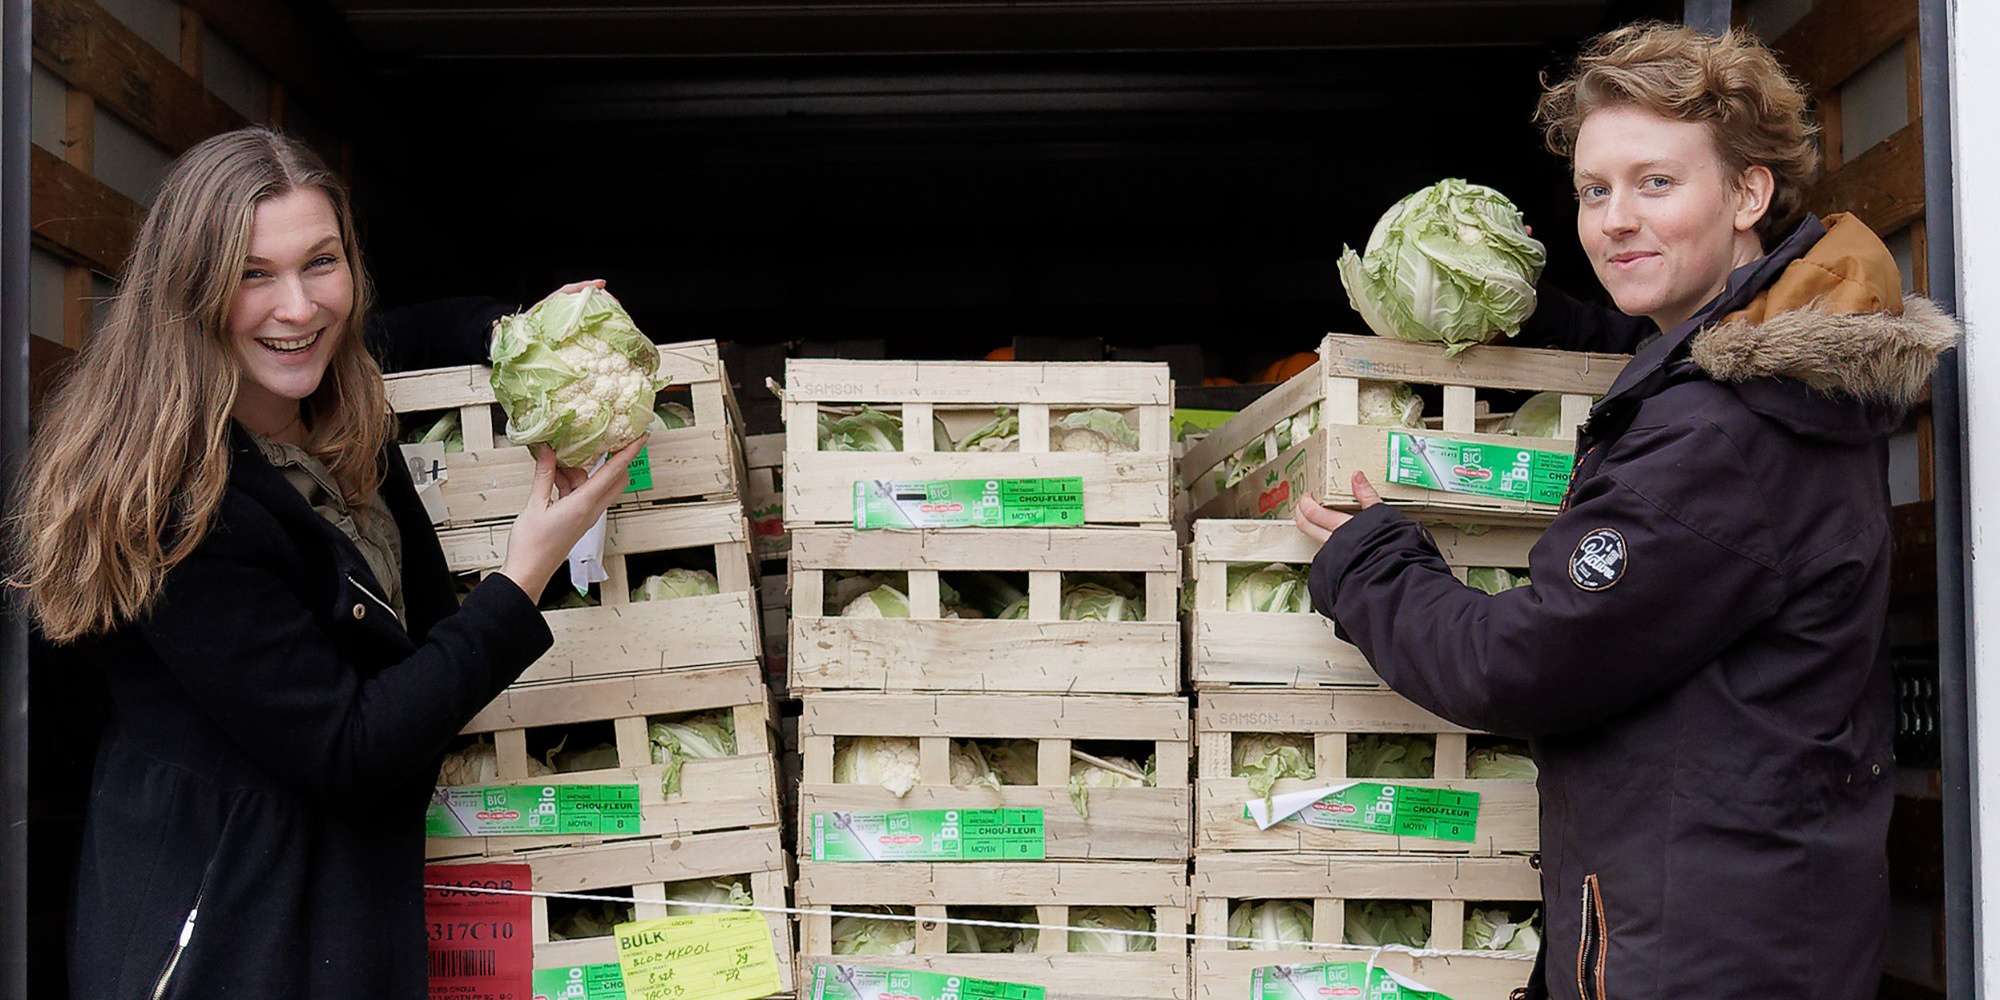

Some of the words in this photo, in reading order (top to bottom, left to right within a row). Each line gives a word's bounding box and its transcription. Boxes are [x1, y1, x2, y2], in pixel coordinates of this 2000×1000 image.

[804, 383, 864, 396] SAMSON
[874, 383, 880, 396] 1
[1462, 453, 1482, 464] BIO
[1511, 451, 1530, 480] Bio
[930, 487, 950, 500] BIO
[982, 480, 999, 506] Bio
[1018, 495, 1076, 503] CHOU-FLEUR
[1060, 511, 1067, 520] 8
[1219, 712, 1281, 725] SAMSON
[487, 794, 507, 806] BIO
[538, 787, 556, 814] Bio
[1376, 786, 1395, 813] Bio
[1413, 805, 1470, 818] CHOU-FLEUR
[617, 819, 624, 828] 8
[890, 818, 910, 830] BIO
[941, 810, 959, 839] Bio
[1403, 822, 1428, 831] MOYEN
[978, 827, 1036, 835] CHOU-FLEUR
[1451, 826, 1459, 835] 8
[1020, 844, 1028, 853] 8
[621, 932, 665, 950] BULK
[567, 967, 584, 996] Bio
[1329, 970, 1349, 981] BIO
[890, 977, 911, 988] BIO
